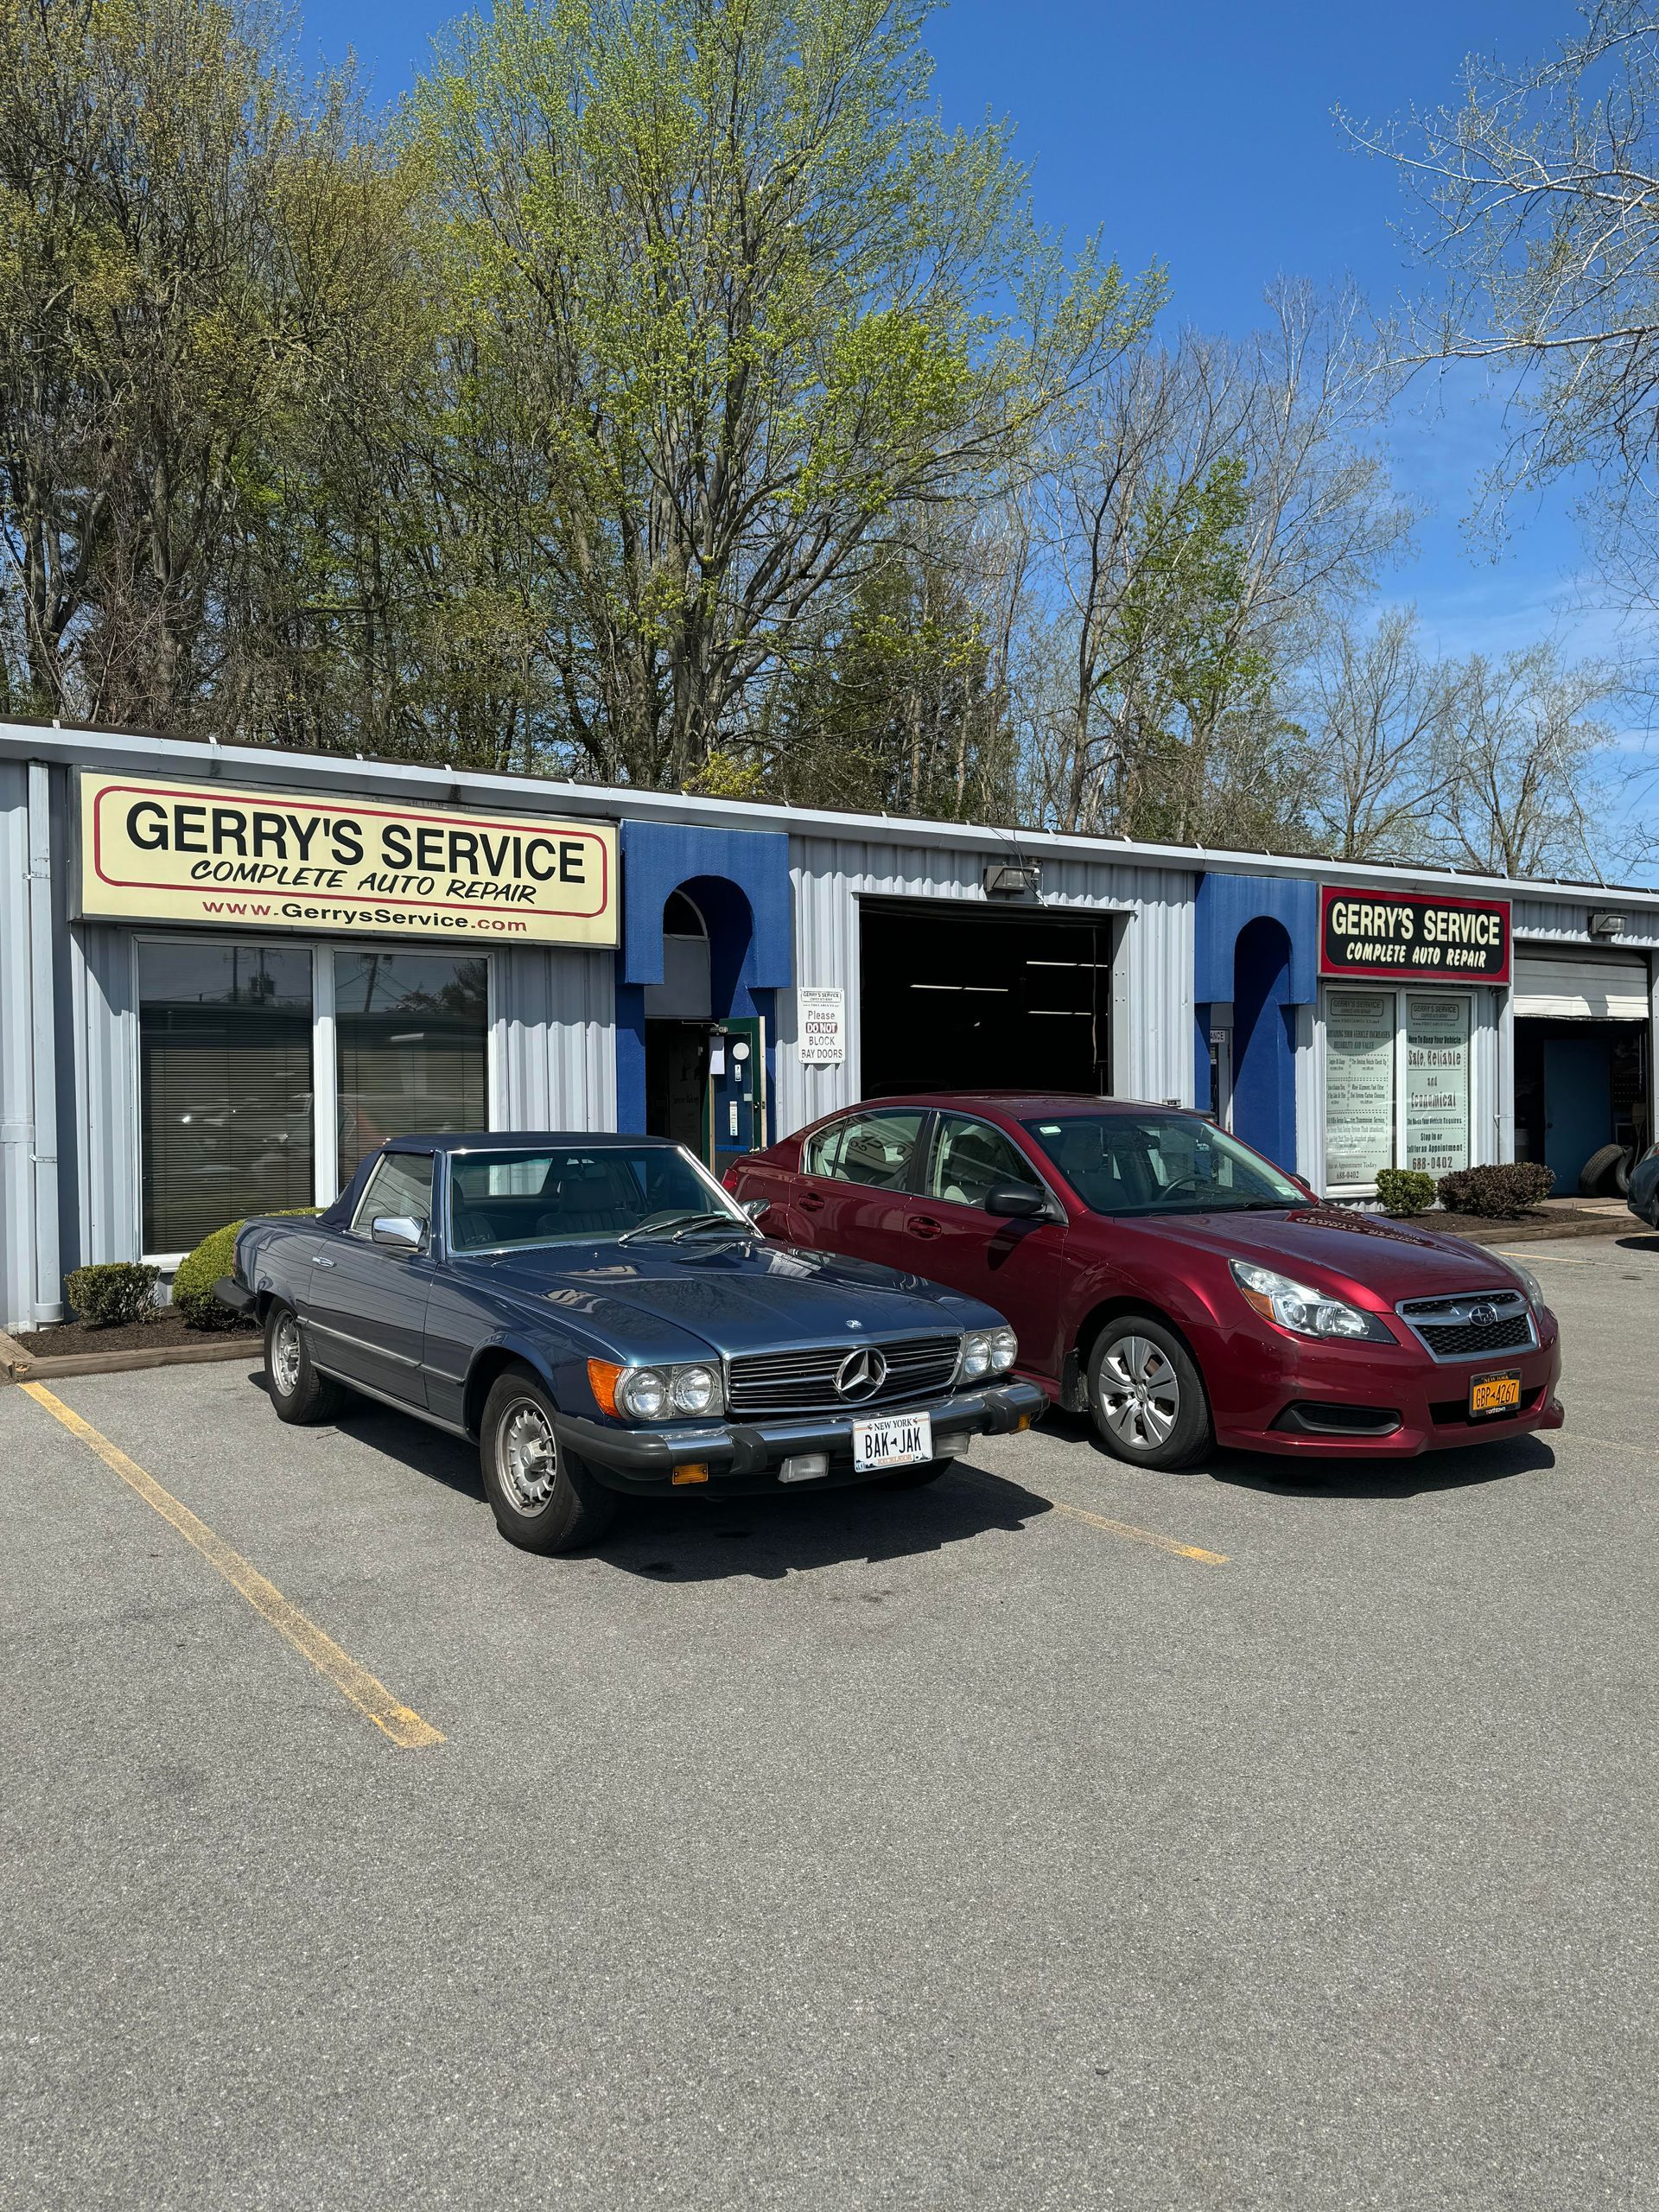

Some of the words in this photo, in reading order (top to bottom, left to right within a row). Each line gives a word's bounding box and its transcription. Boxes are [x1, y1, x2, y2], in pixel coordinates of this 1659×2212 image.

[126, 800, 365, 867] GERRY'S
[381, 823, 587, 885] SERVICE
[190, 860, 346, 889] COMPLETE
[357, 872, 435, 896] AUTO
[445, 879, 537, 905] REPAIR
[202, 899, 527, 932] www.GerrysService.com
[1332, 901, 1414, 940] GERRY'S
[1423, 909, 1500, 946] SERVICE
[1346, 941, 1407, 963] COMPLETE
[1412, 945, 1441, 965] AUTO
[1446, 948, 1487, 969] REPAIR
[808, 1010, 836, 1020] Please
[807, 1022, 819, 1033] DO
[819, 1022, 836, 1033] NOT
[809, 1036, 836, 1046] BLOCK
[801, 1049, 815, 1058] BAY
[817, 1049, 842, 1058] DOORS
[1427, 1050, 1461, 1067] Reliable
[1427, 1076, 1438, 1087] and
[1411, 1091, 1456, 1108] Economical
[1420, 1133, 1431, 1141] Stop
[1428, 1144, 1463, 1154] Appointment
[1412, 1156, 1453, 1171] 688-0402
[1476, 1386, 1491, 1408] GBP
[1496, 1382, 1516, 1404] 4267
[874, 1421, 892, 1431] NEW
[893, 1418, 912, 1428] YORK
[865, 1431, 889, 1459] BAK
[899, 1427, 921, 1453] JAK
